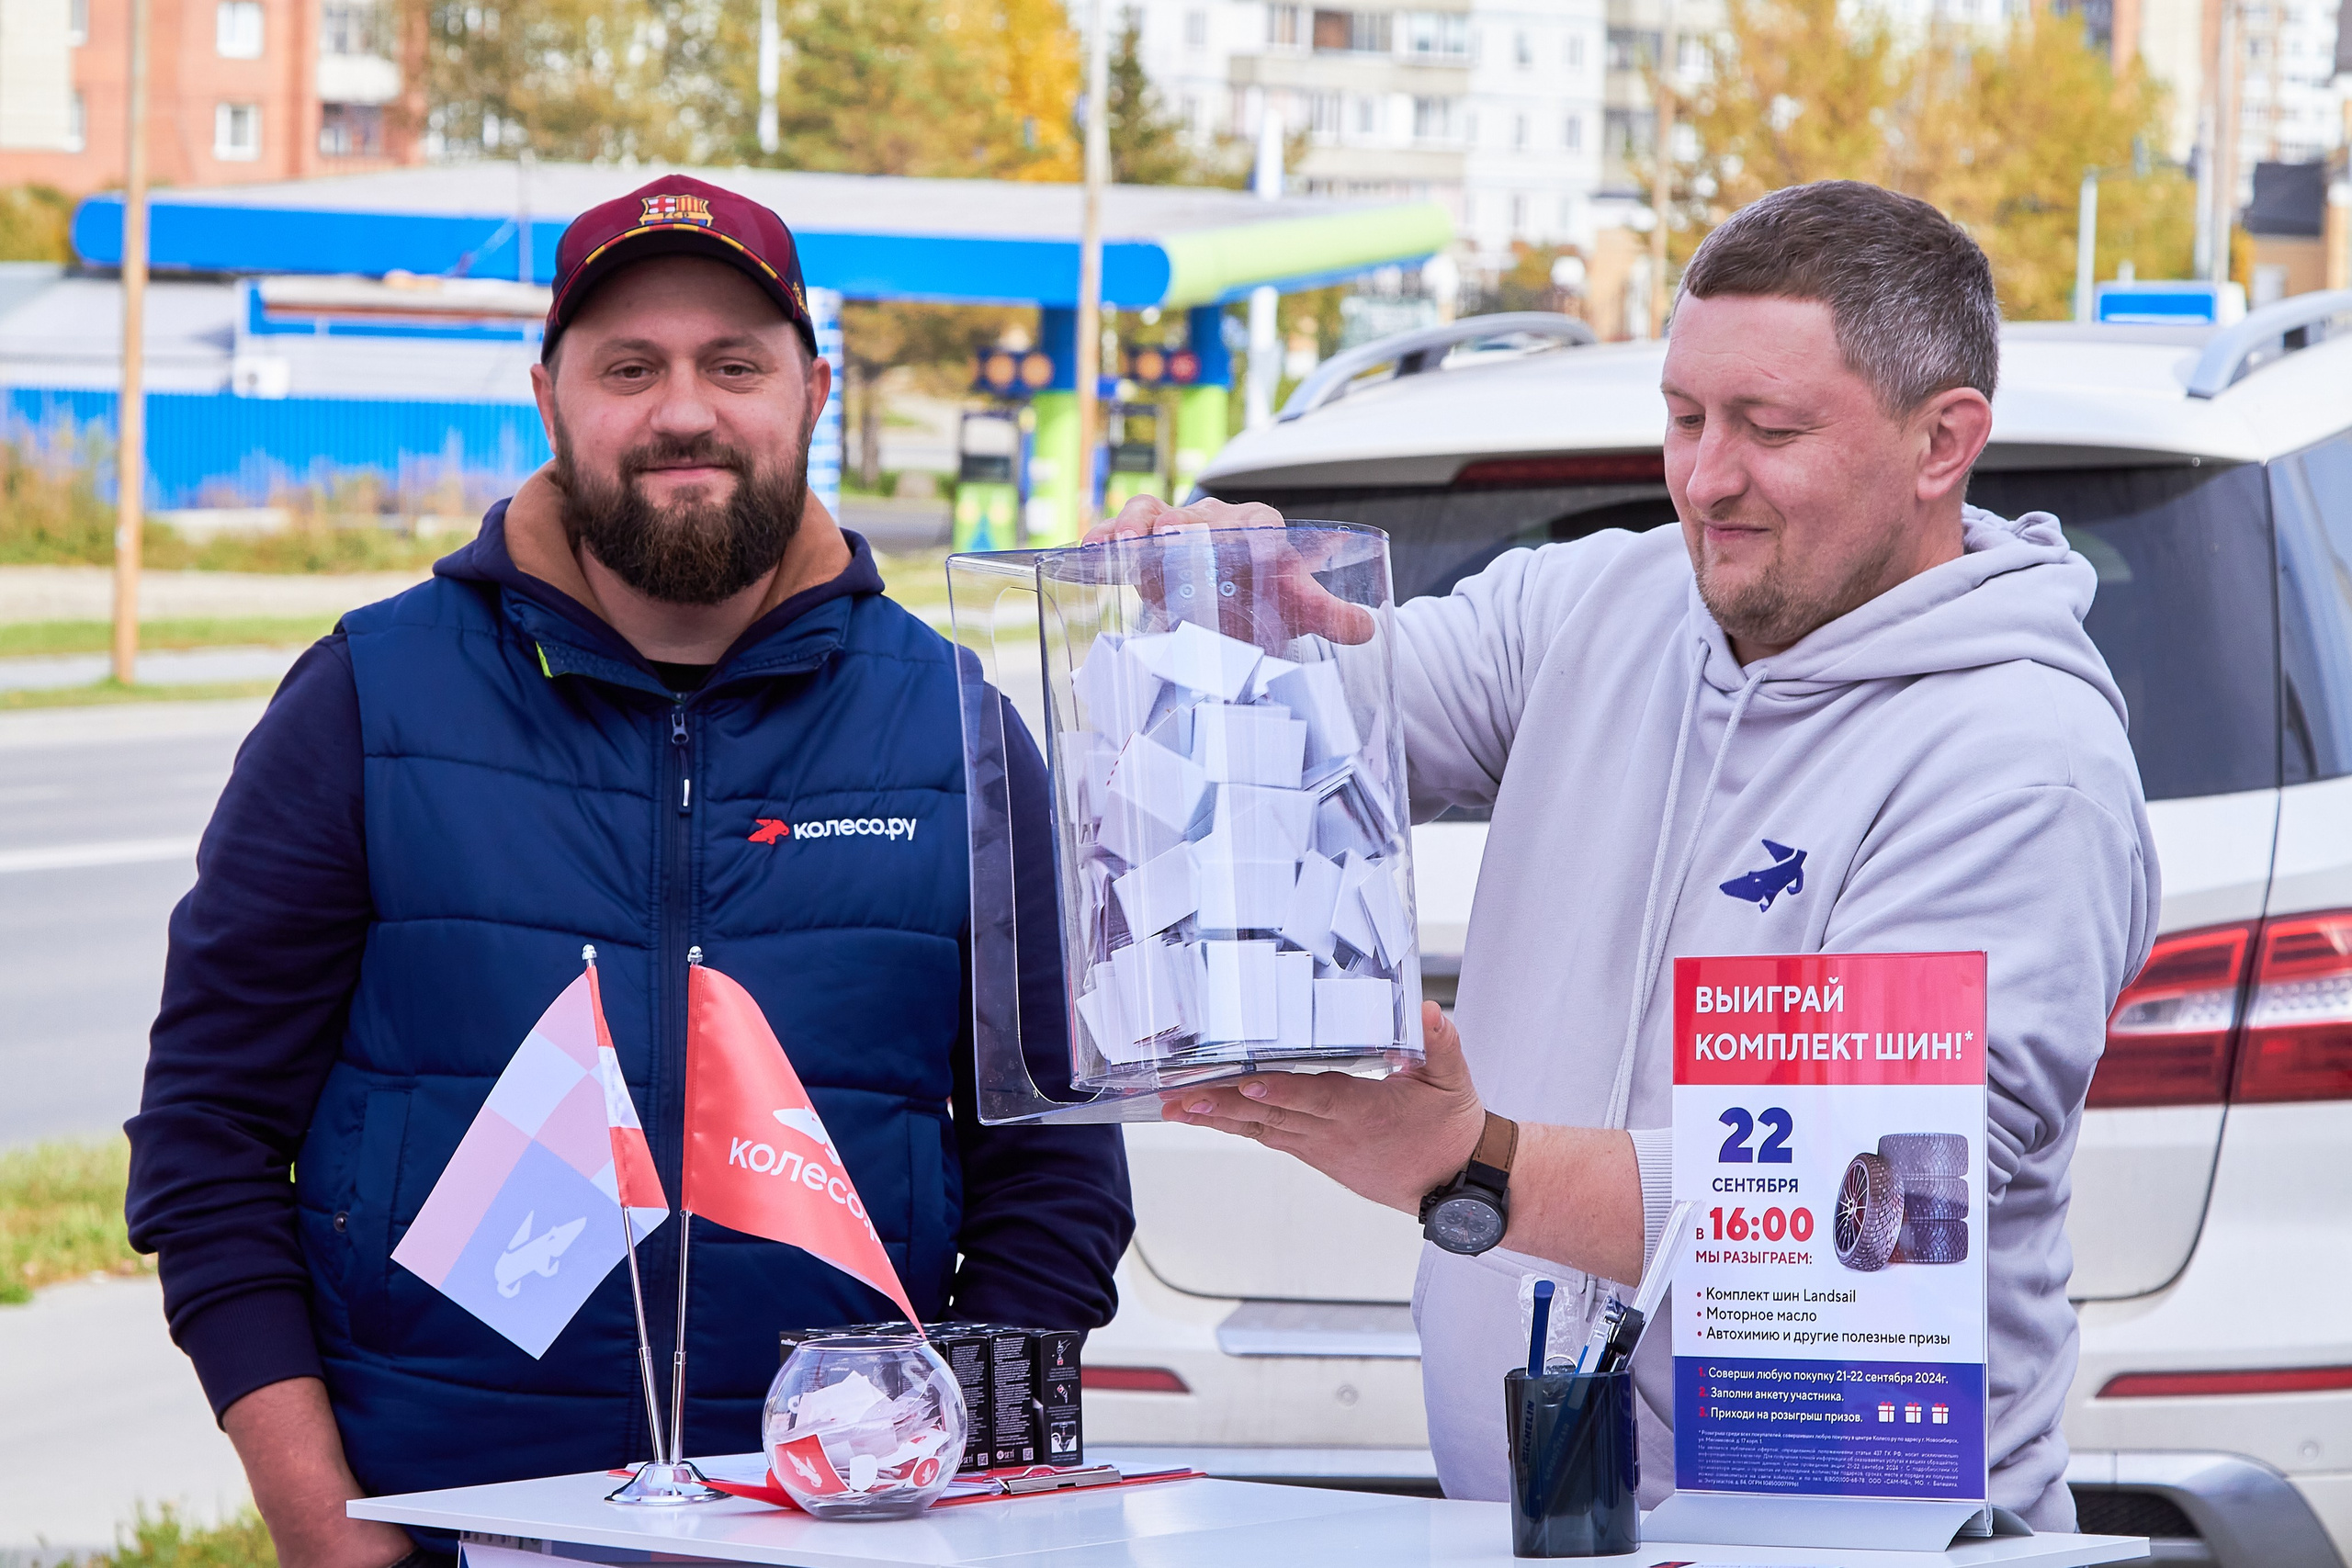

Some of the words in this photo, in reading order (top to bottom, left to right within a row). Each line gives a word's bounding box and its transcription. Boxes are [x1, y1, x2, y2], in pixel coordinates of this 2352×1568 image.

[793, 818, 917, 840] колесо.ру
[1695, 976, 1845, 1014] ВЫИГРАЙ
[1695, 1032, 1869, 1061] КОМПЛЕКТ
[1717, 1106, 1794, 1164] 22
[1712, 1178, 1799, 1193] СЕНТЯБРЯ
[1709, 1206, 1815, 1242] 16:00
[1695, 1250, 1722, 1264] МЫ
[1723, 1251, 1813, 1265] РАЗЫГРАЕМ:
[1705, 1287, 1770, 1303] Комплект
[1772, 1290, 1800, 1303] шин
[1804, 1289, 1857, 1303] Landsail
[1705, 1307, 1774, 1324] Моторное
[1777, 1310, 1817, 1323] масло
[1706, 1326, 1781, 1342] Автохимию
[1782, 1331, 1791, 1342] и
[1793, 1331, 1838, 1346] другие
[1842, 1332, 1906, 1345] полезные
[1909, 1334, 1951, 1348] призы
[1699, 1367, 1706, 1377] 1.
[1708, 1366, 1755, 1382] Соверши
[1757, 1369, 1792, 1382] любую
[1793, 1371, 1836, 1384] покупку
[1837, 1370, 1863, 1382] 21-22
[1865, 1371, 1914, 1384] сентября
[1915, 1372, 1950, 1385] 2024г.
[1699, 1386, 1708, 1397] 2.
[1711, 1386, 1753, 1399] Заполни
[1755, 1390, 1788, 1403] анкету
[1790, 1391, 1845, 1403] участника.
[1711, 1406, 1752, 1420] Приходи
[1757, 1411, 1770, 1420] на
[1770, 1411, 1823, 1424] розыгрыш
[1825, 1413, 1863, 1425] призов.
